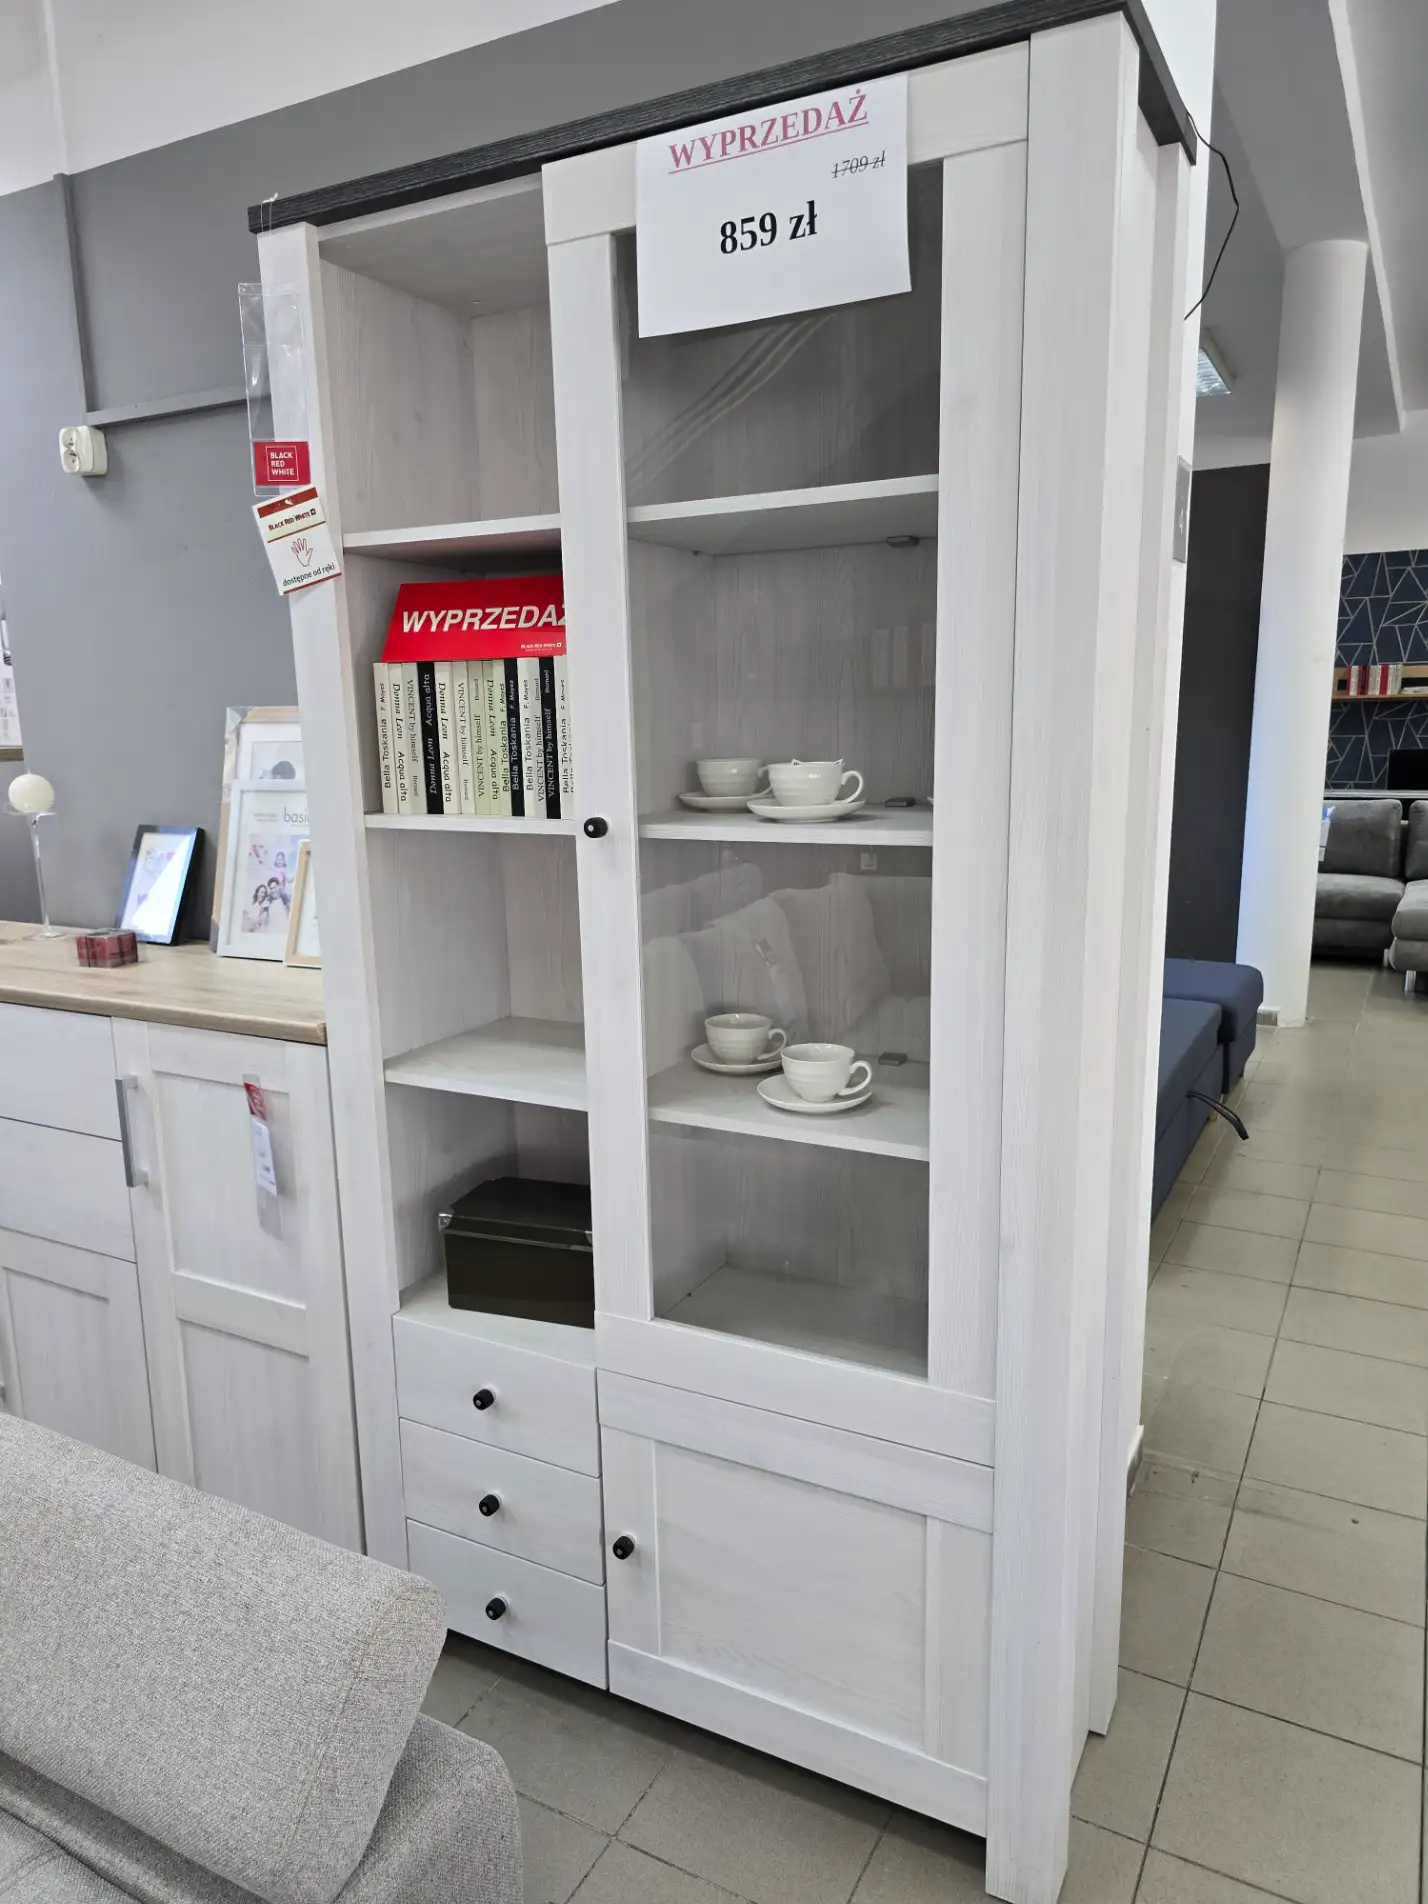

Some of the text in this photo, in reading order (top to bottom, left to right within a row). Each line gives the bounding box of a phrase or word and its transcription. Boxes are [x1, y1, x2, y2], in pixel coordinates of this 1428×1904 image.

[669, 89, 868, 170] WYPRZEDAŻ
[832, 150, 887, 178] 1709 zł
[720, 199, 817, 254] 859 zł
[283, 563, 335, 587] dostępne od ręki
[407, 680, 416, 721] VINCENT
[458, 683, 466, 726] VINCENT
[394, 718, 404, 740] Leon
[408, 722, 416, 732] by
[440, 718, 449, 740] Leon
[460, 726, 466, 735] by
[474, 714, 482, 743] himself
[534, 715, 542, 747] himself
[545, 709, 553, 740] himself
[411, 734, 419, 763] himself
[461, 736, 469, 765] himself
[476, 746, 483, 754] by
[500, 721, 509, 765] Toskania
[510, 718, 518, 762] Toskania
[524, 718, 532, 761] Toskania
[536, 748, 543, 756] by
[546, 741, 554, 752] by
[397, 752, 405, 780] Acqua
[442, 752, 450, 781] Acqua
[476, 758, 485, 796] VINCENT
[502, 768, 510, 792] Bella
[512, 766, 520, 790] Bella
[546, 754, 554, 797] VINCENT
[444, 784, 452, 803] alta
[536, 760, 545, 802] VINCENT
[284, 806, 309, 823] basi
